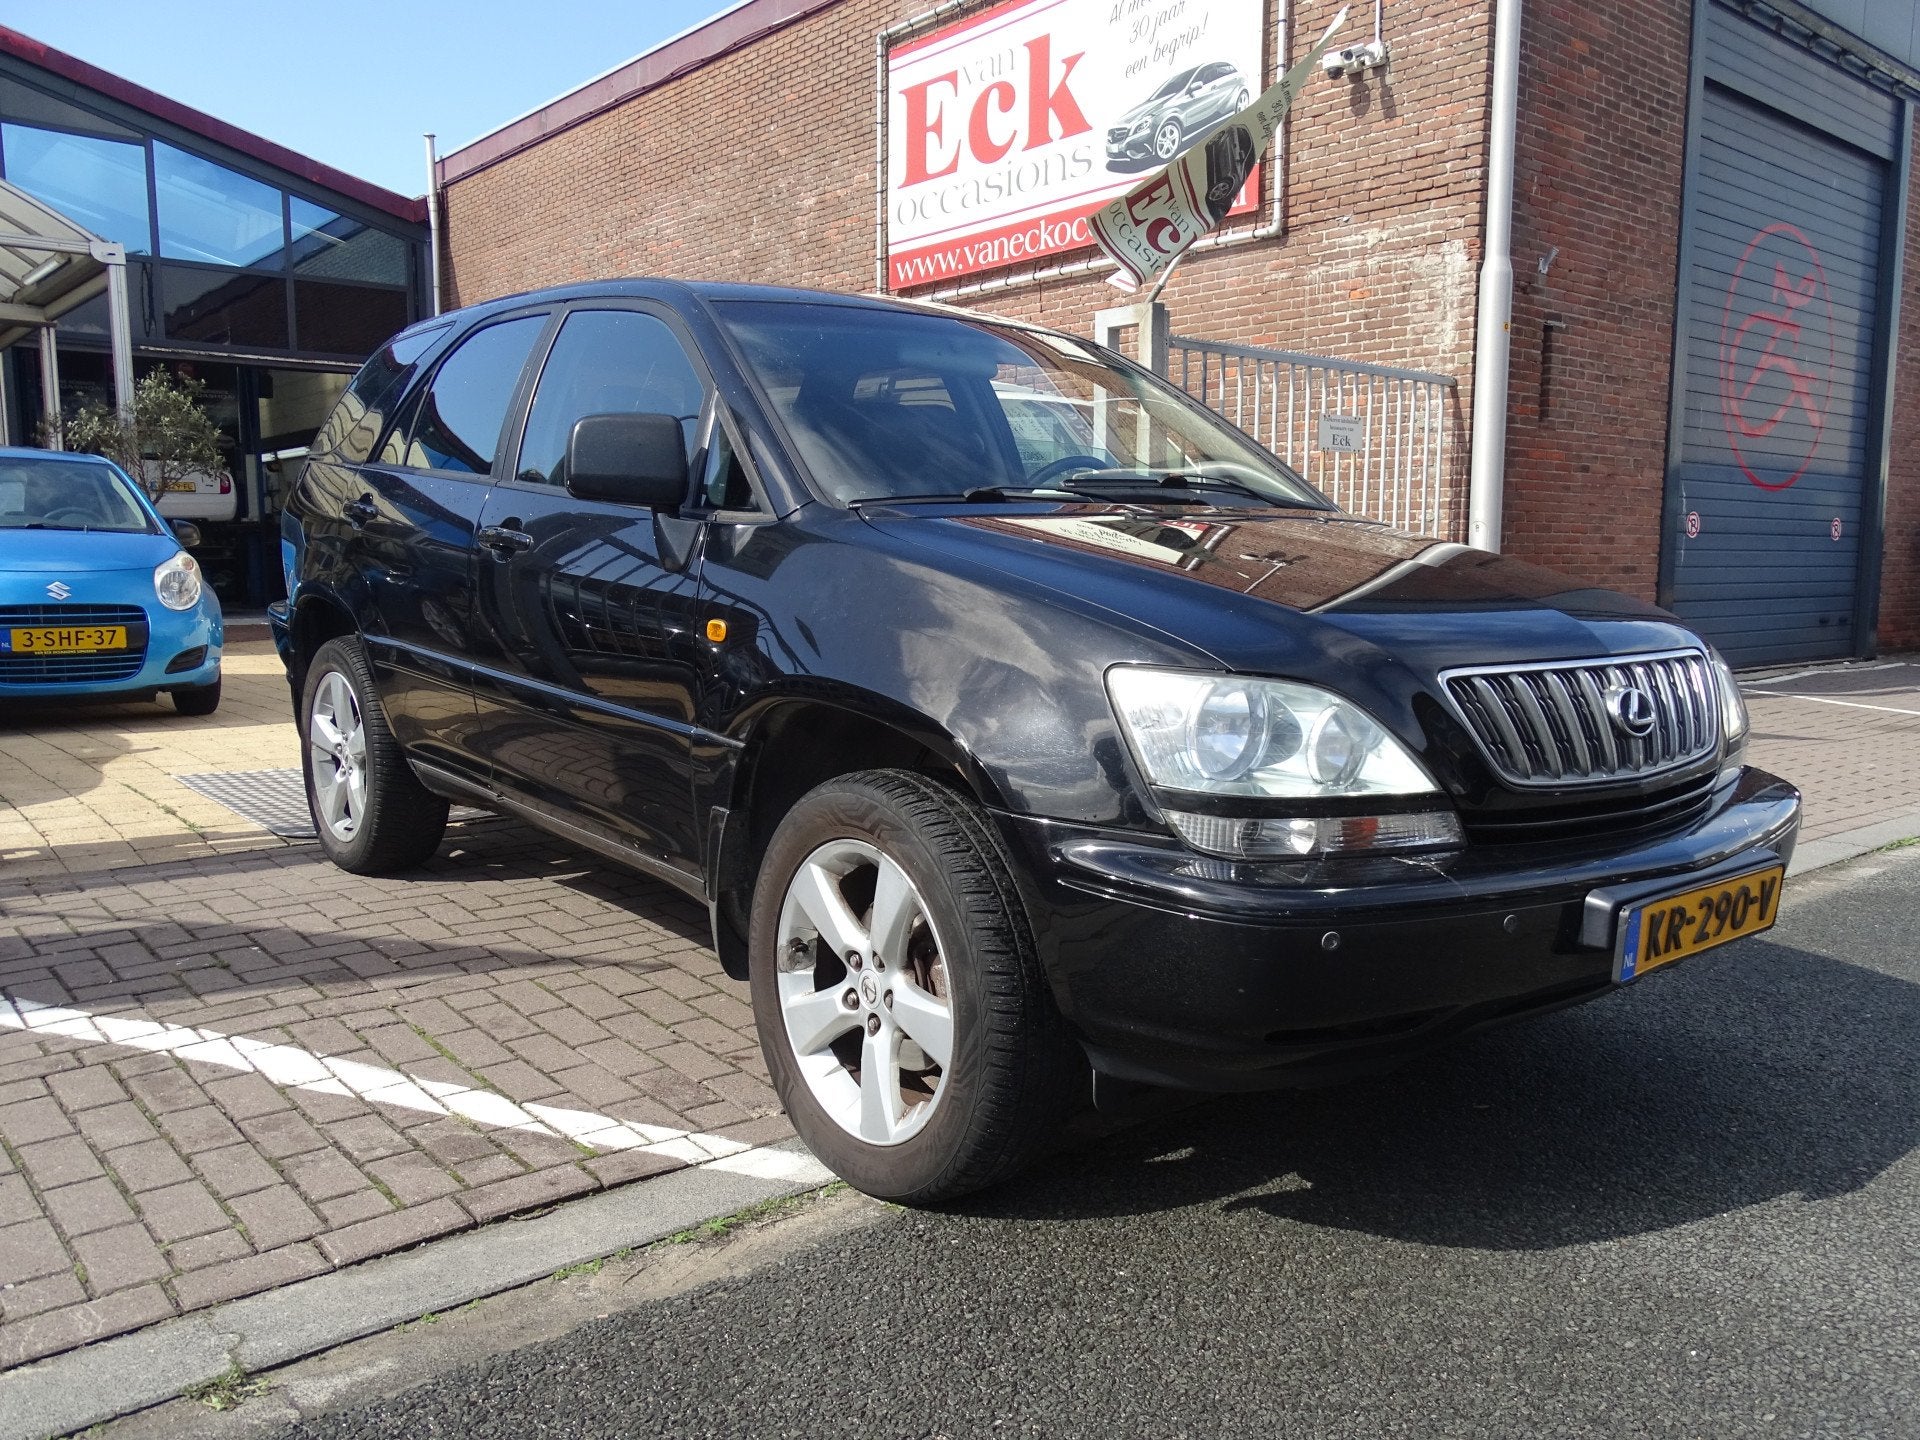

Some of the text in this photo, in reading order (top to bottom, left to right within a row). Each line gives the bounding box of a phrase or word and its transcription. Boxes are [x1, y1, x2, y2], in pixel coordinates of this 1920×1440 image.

[1129, 0, 1186, 44] 30 jaar
[961, 47, 1015, 87] van
[1125, 11, 1209, 79] een begrip!
[898, 33, 1093, 189] Eck
[896, 145, 1093, 225] occasions
[1126, 170, 1191, 263] Ec
[1167, 198, 1191, 235] van
[1332, 434, 1351, 447] Eck
[22, 629, 117, 648] 3-SHF-37
[1644, 876, 1777, 962] KR-290-V
[1623, 954, 1635, 970] NL
